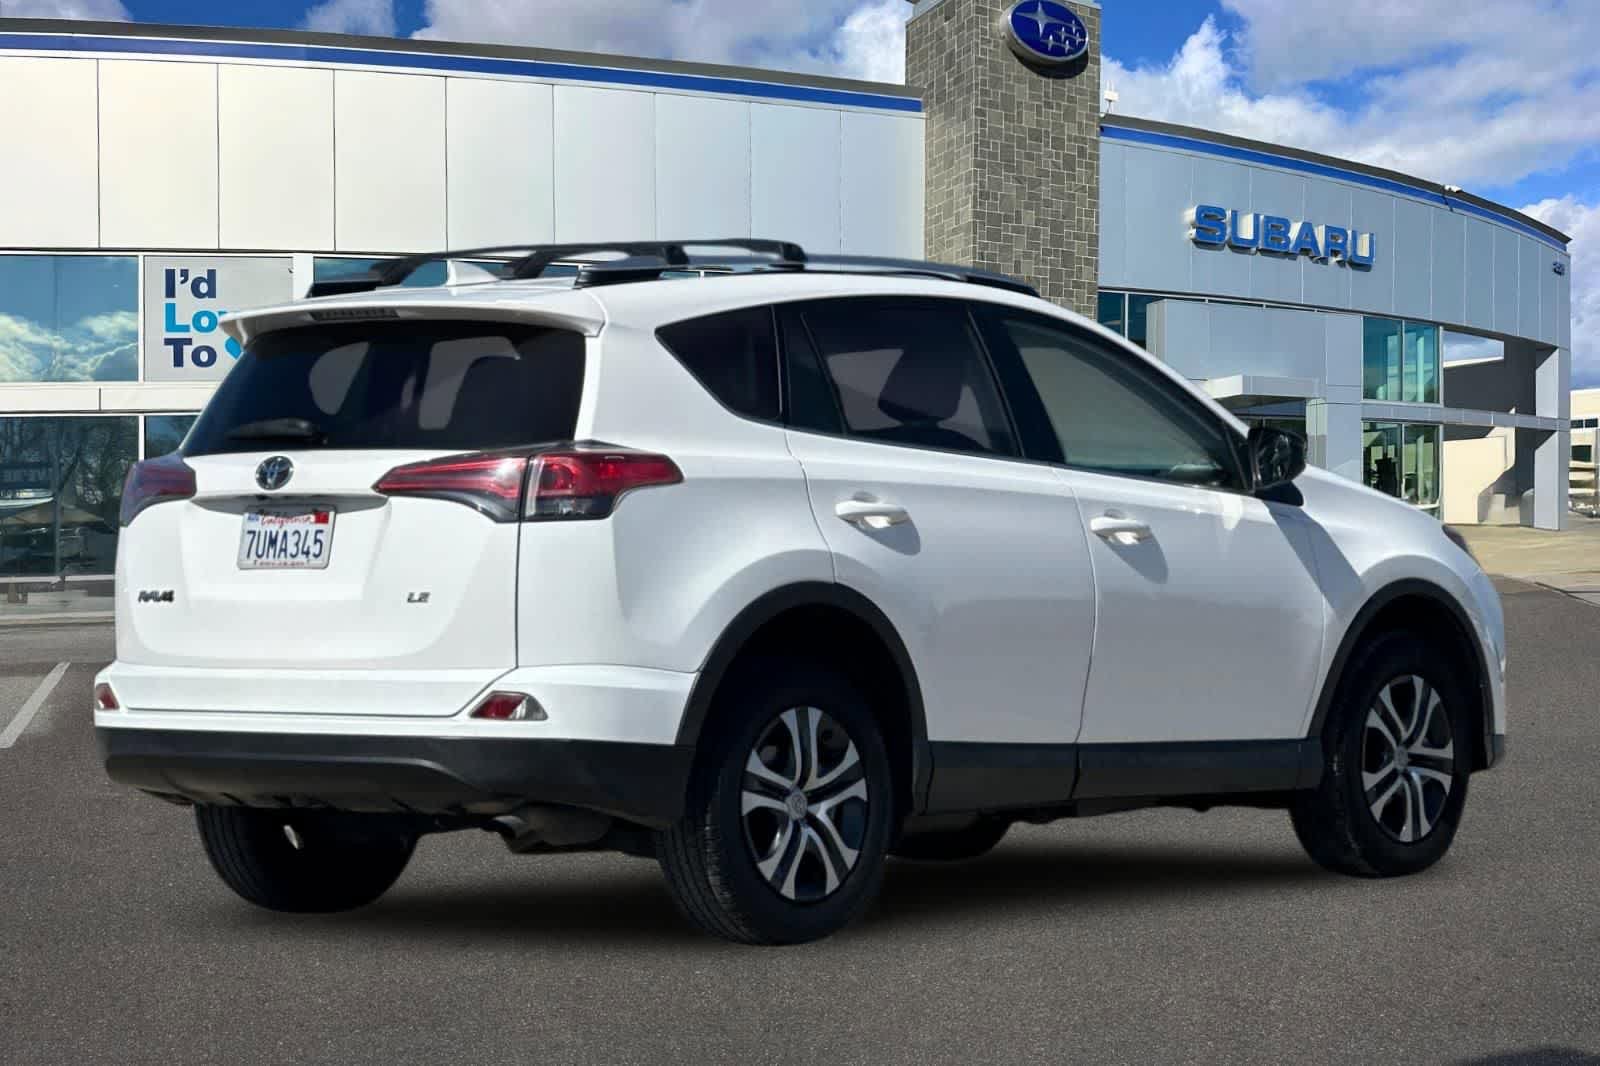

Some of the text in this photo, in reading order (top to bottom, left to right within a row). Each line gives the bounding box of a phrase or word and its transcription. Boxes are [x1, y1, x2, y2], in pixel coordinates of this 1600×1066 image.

[1192, 204, 1376, 268] SUBARU
[164, 268, 217, 299] I’d
[164, 303, 228, 333] Lo
[163, 338, 217, 368] To
[246, 529, 325, 559] 7UMA345
[407, 591, 430, 604] LE
